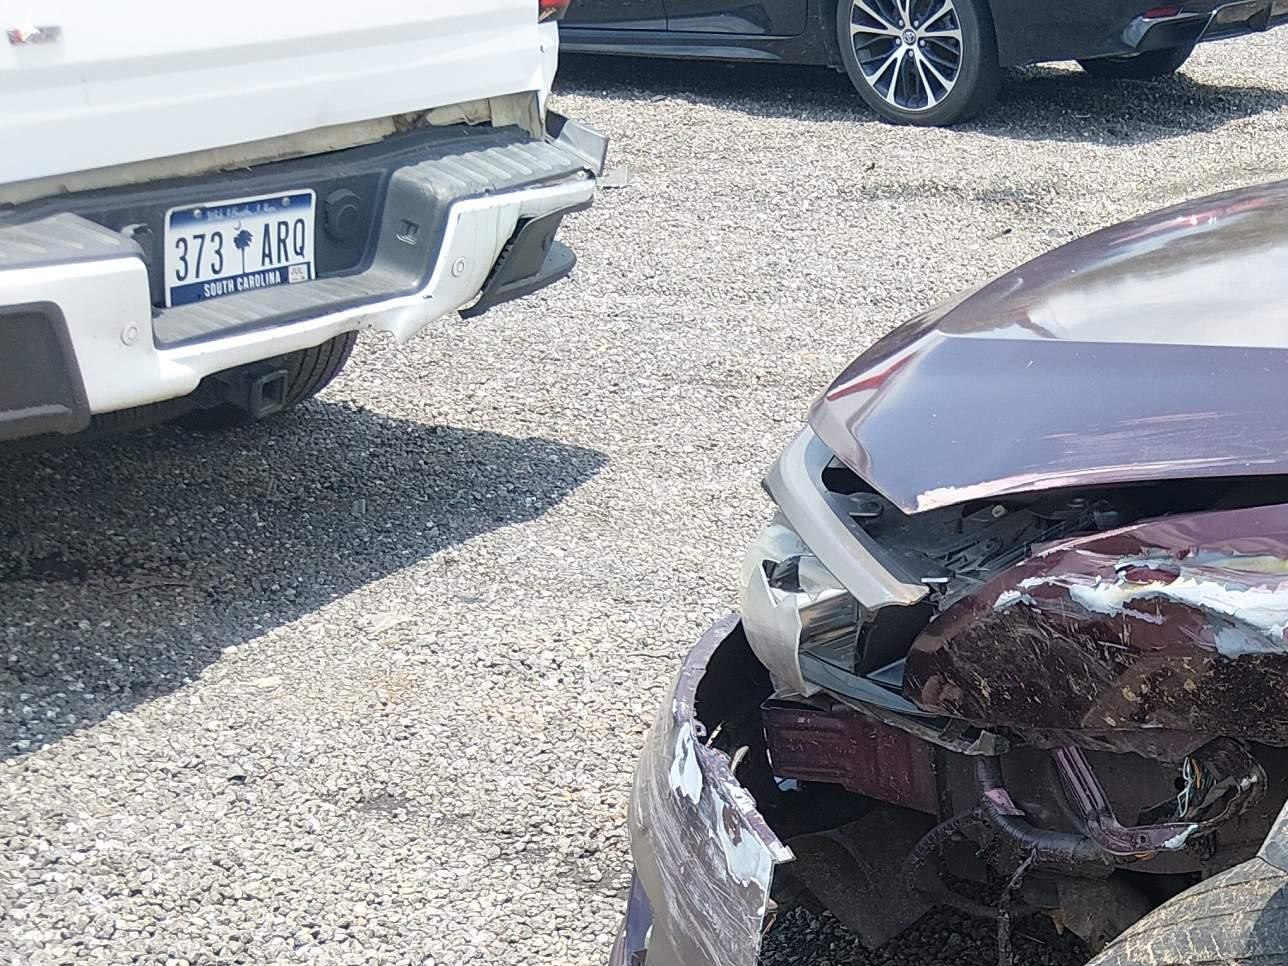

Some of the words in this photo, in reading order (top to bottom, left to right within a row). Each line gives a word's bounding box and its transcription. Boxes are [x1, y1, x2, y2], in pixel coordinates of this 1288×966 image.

[176, 232, 224, 281] 373
[261, 218, 306, 267] ARQ
[204, 282, 235, 298] SOUTH
[237, 270, 282, 291] CAROLINA
